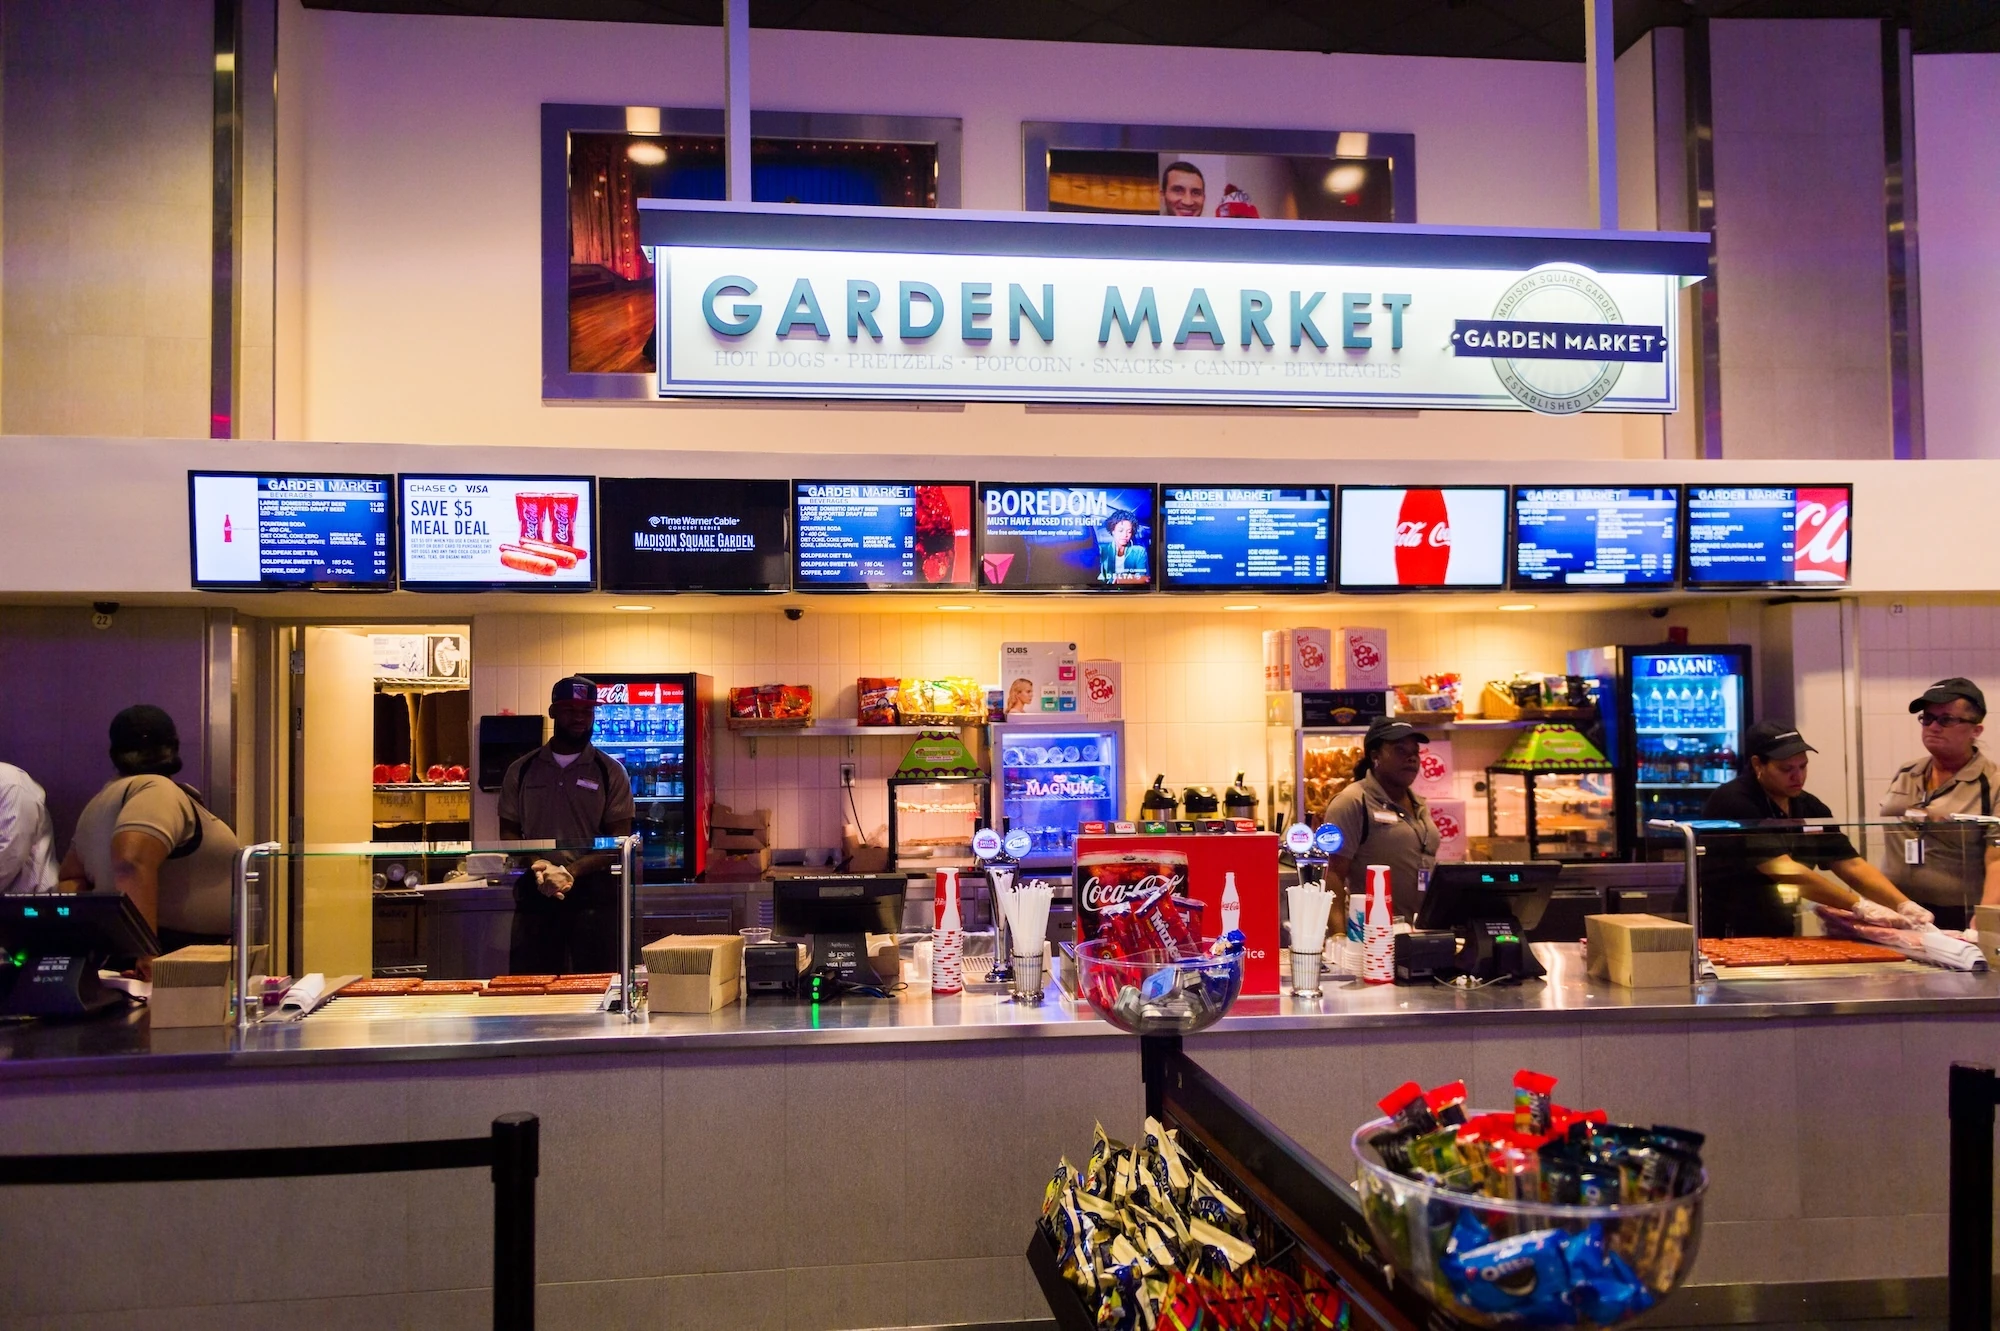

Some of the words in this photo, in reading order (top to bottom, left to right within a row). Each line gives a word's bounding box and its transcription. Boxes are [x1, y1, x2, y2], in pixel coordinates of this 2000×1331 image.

[1498, 279, 1536, 318] MADISON
[1539, 274, 1582, 287] SQUARE
[1585, 284, 1617, 322] GARDEN
[702, 275, 1055, 344] GARDEN
[1099, 286, 1412, 350] MARKET
[1464, 329, 1556, 350] GARDEN
[1564, 333, 1656, 352] MARKET
[714, 350, 758, 368] HOT
[767, 351, 826, 369] DOGS
[848, 353, 954, 372] PRETZELS
[974, 355, 1073, 374] POPCORN
[1092, 357, 1174, 376] SNACKS
[1194, 360, 1264, 378] CANDY
[1284, 361, 1401, 381] BEVERAGES
[1505, 376, 1582, 410] ESTABLISHED
[1587, 378, 1611, 402] 1879
[268, 480, 325, 491] GARDEN
[328, 481, 382, 493] MARKET
[410, 485, 446, 493] CHASE
[466, 485, 488, 493] VISA
[808, 487, 859, 497] GARDEN
[863, 487, 910, 498] MARKET
[1175, 491, 1224, 501] GARDEN
[1227, 491, 1272, 501] MARKET
[1526, 490, 1575, 501] GARDEN
[1576, 491, 1622, 501] MARKET
[1698, 490, 1746, 500] GARDEN
[1748, 490, 1793, 500] MARKET
[411, 500, 448, 516] SAVE
[454, 499, 472, 518] $5
[986, 490, 1107, 516] BOREDOM
[660, 516, 681, 525] Time
[682, 516, 712, 525] Warner
[713, 517, 737, 525] Cable
[987, 517, 1009, 526] MUST
[1010, 517, 1031, 526] HAVE
[1032, 517, 1060, 526] MISSED
[1061, 518, 1073, 526] ITS
[1075, 518, 1103, 526] FLIGHT.
[411, 521, 449, 535] MEAL
[455, 521, 490, 535] DEAL
[634, 532, 677, 547] MADISON
[680, 533, 715, 549] SQUARE
[1893, 604, 1903, 614] 23
[96, 614, 108, 625] 22
[1300, 645, 1317, 659] POP
[1353, 645, 1372, 659] POP
[1303, 653, 1324, 668] CORN
[1357, 652, 1379, 668] CORN
[1656, 656, 1713, 676] DASANI
[1088, 678, 1106, 691] POP
[1091, 685, 1113, 700] CORN
[1026, 780, 1094, 796] MAGNUM
[378, 795, 413, 805] TERRA
[1222, 901, 1239, 911] Coca-Cola
